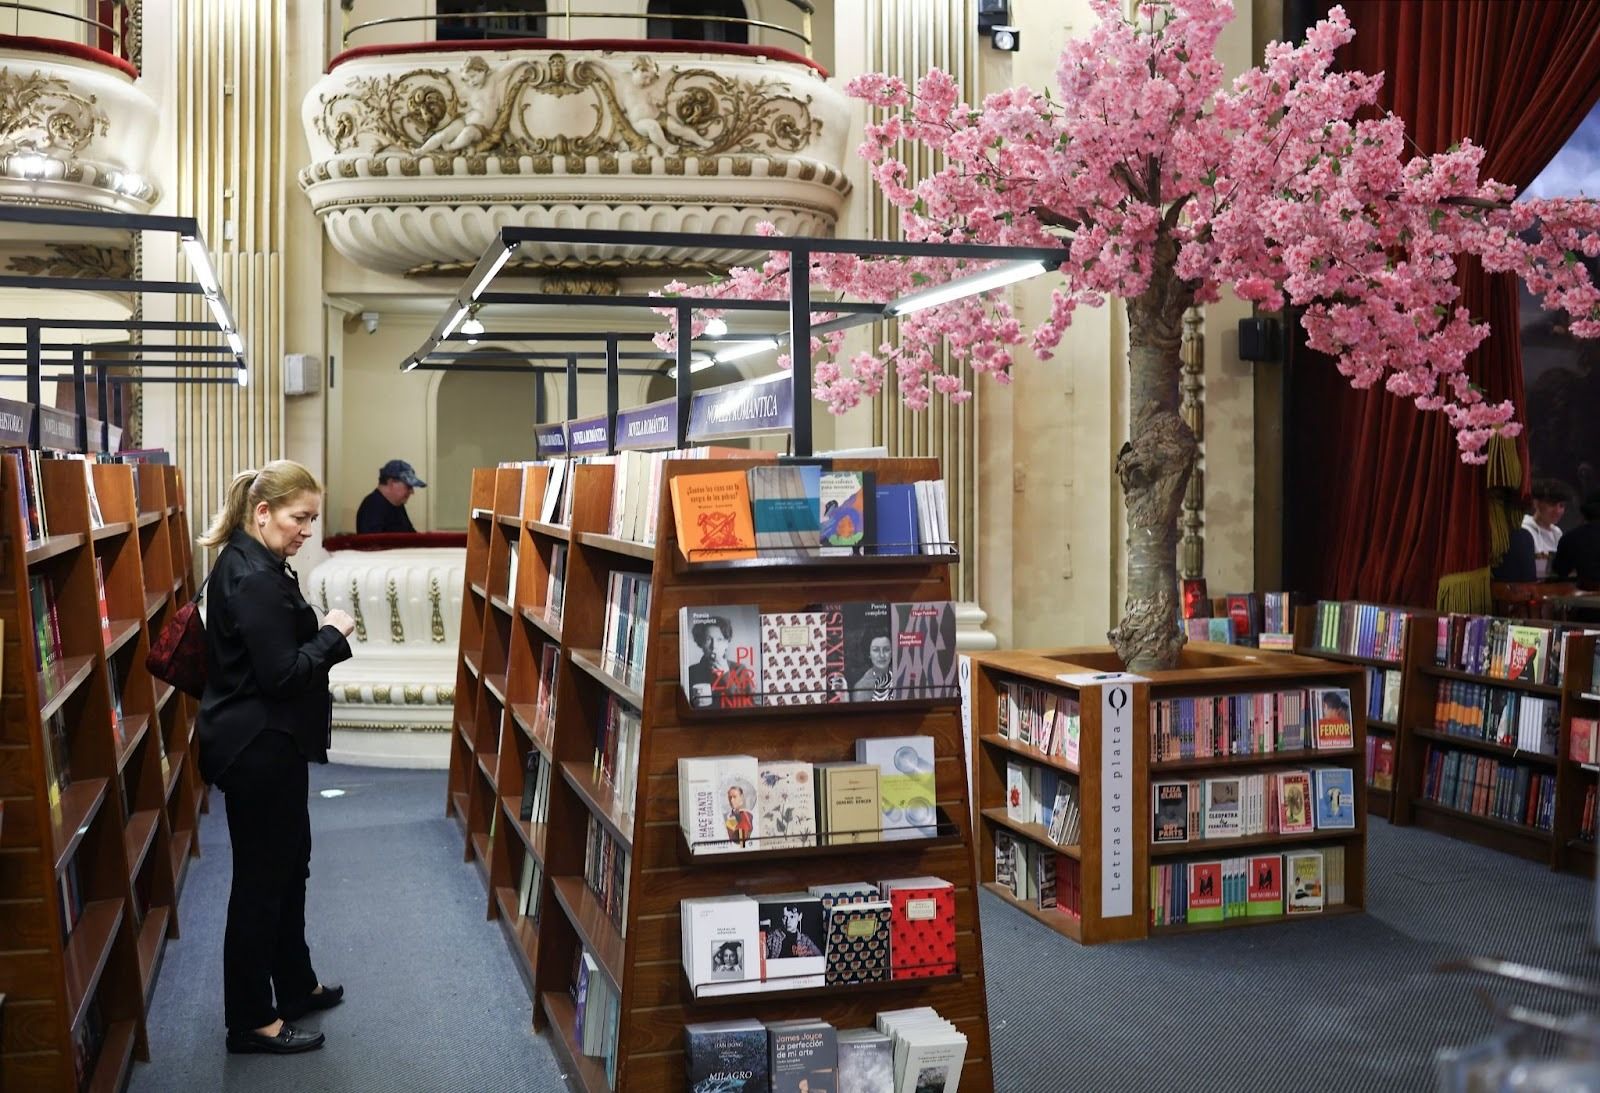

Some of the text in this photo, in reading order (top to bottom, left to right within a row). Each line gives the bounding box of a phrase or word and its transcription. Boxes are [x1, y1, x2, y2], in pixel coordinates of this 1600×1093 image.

[736, 646, 754, 667] PI
[711, 668, 757, 692] ZAR
[1319, 723, 1350, 737] FERVOR
[697, 791, 707, 816] TANTO
[1111, 726, 1123, 891] Letras de plata
[1208, 811, 1239, 820] CLEOPATRA
[698, 817, 708, 838] HACE
[776, 1032, 823, 1043] James Joyce
[776, 1039, 824, 1052] La perfección
[776, 1048, 814, 1059] de mi arte
[708, 1069, 753, 1082] MILAGRO
